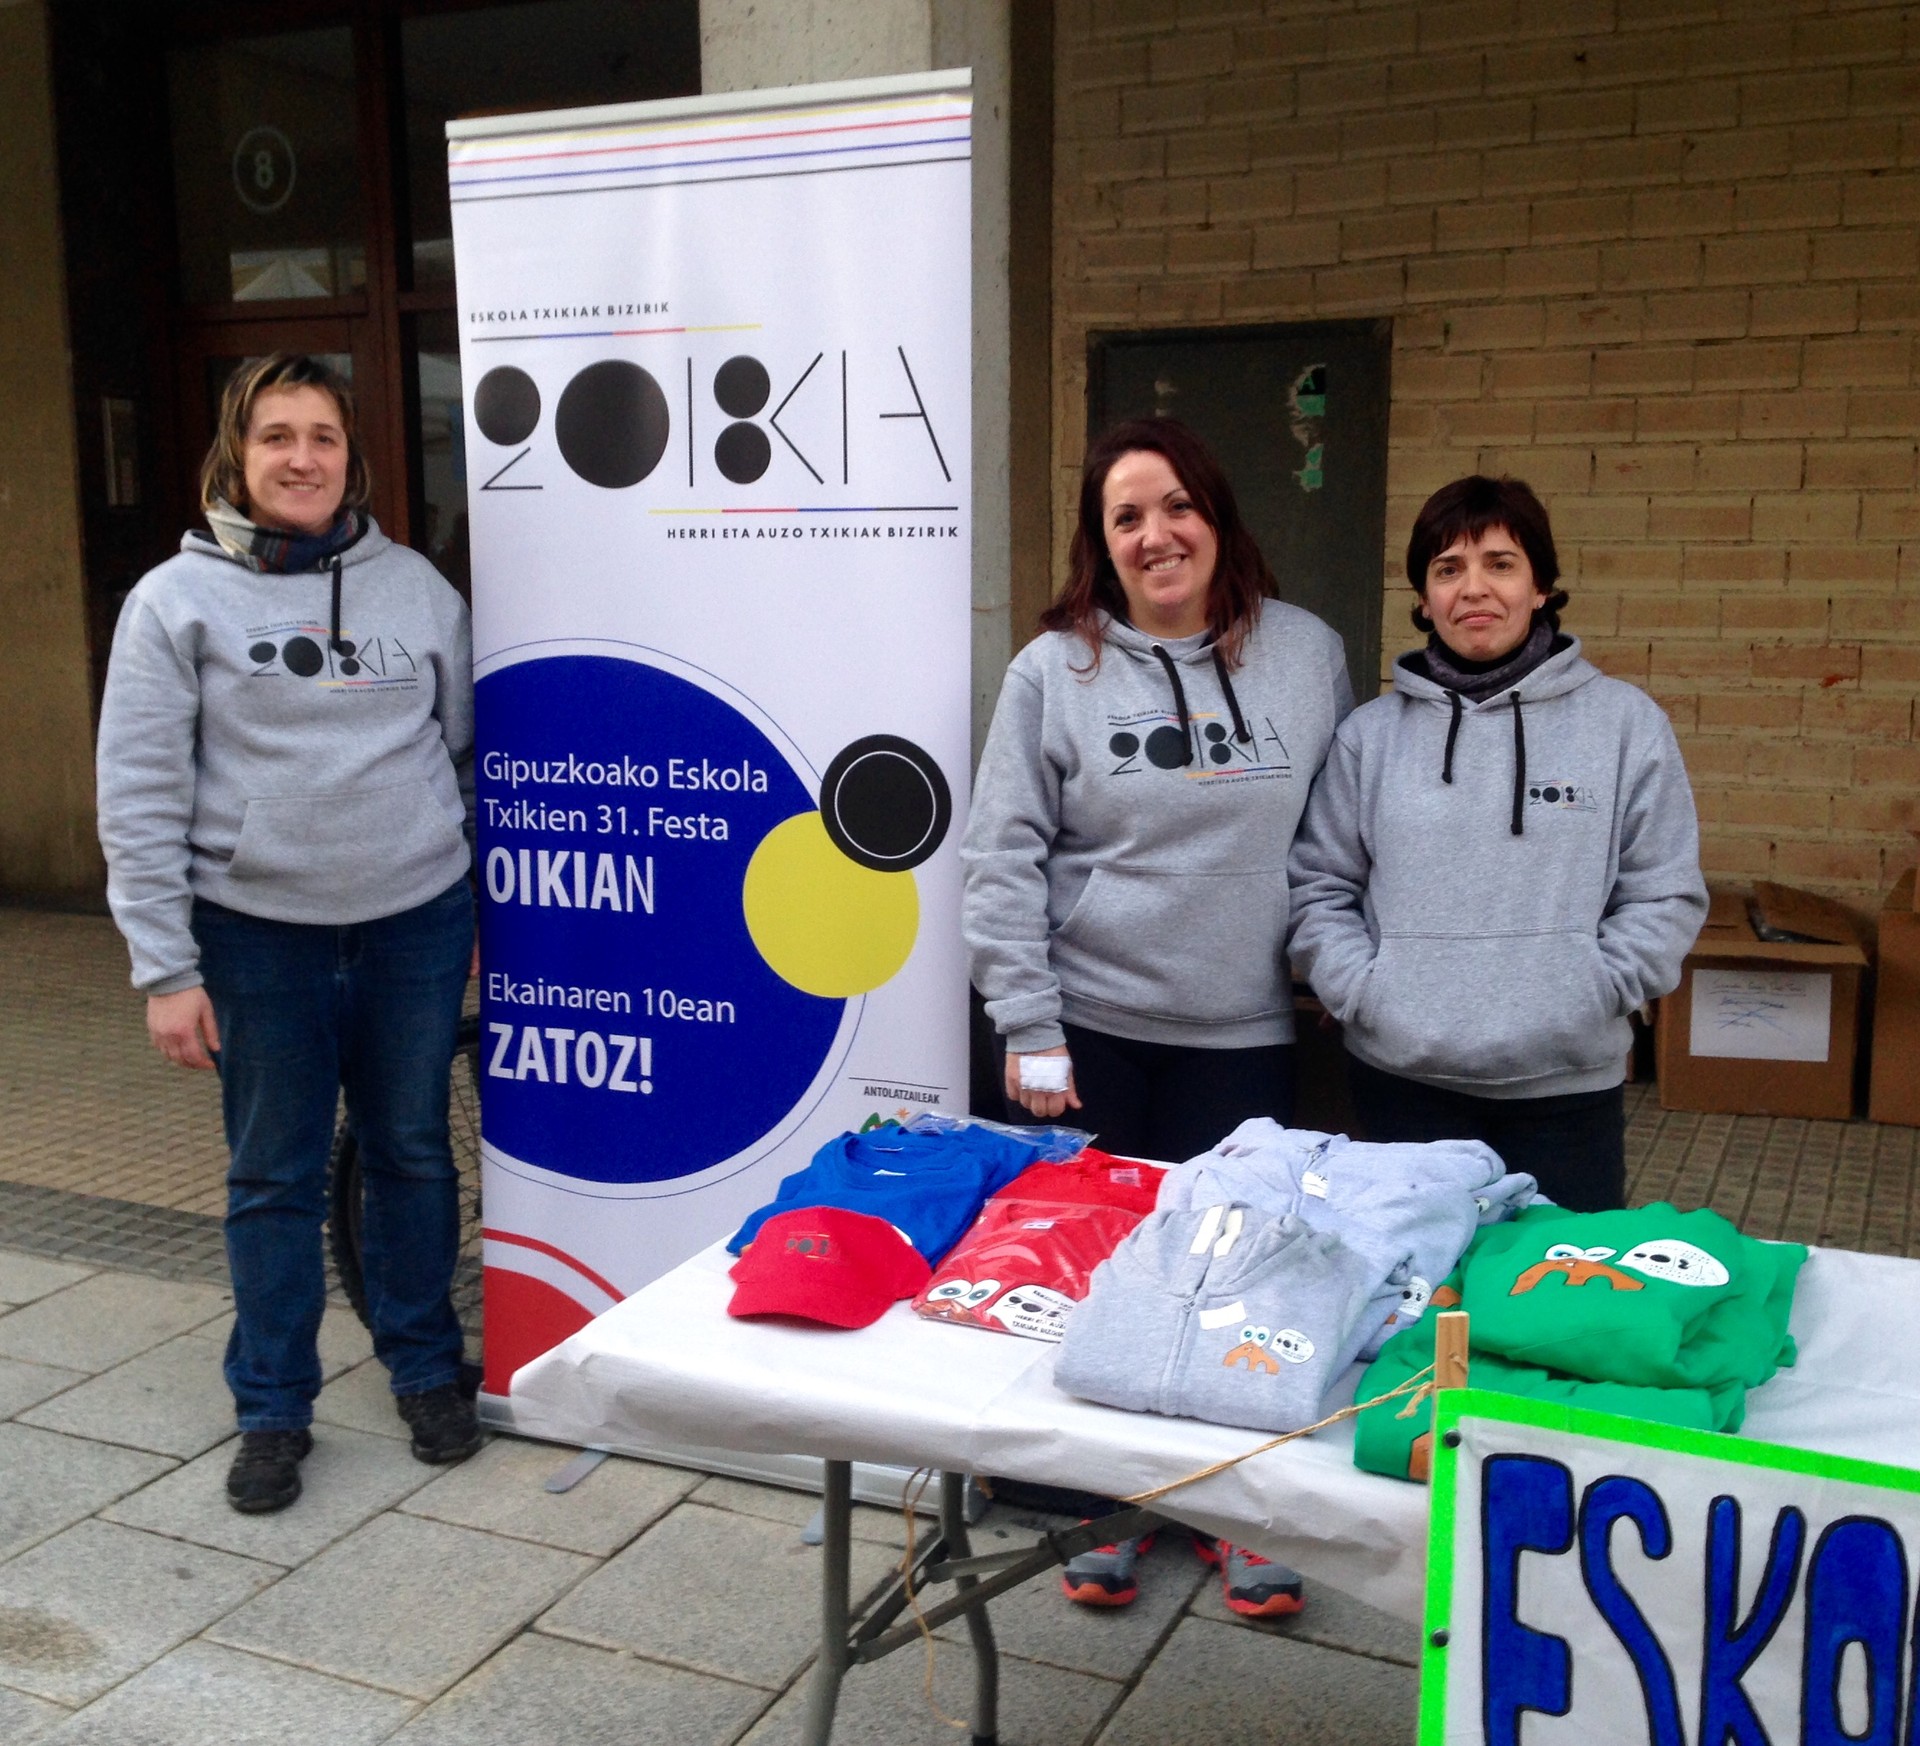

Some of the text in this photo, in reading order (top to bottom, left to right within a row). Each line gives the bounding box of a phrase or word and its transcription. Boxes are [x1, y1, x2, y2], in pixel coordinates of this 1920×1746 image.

[253, 150, 275, 190] 8
[470, 301, 670, 323] ESKOLA TXIKIAK BIZIRIK
[667, 526, 959, 540] HERRI ETA AUZO TXIKIAK BIZIRIK
[483, 751, 769, 793] Gipuzkoako Eskola
[484, 798, 730, 841] Txikien 31. Festa
[485, 846, 655, 915] OIKIAN
[488, 973, 736, 1024] Ekainaren 10ean
[487, 1022, 655, 1095] ZATOZ!
[863, 1085, 941, 1104] ANTOLATZAILEAK
[1481, 1452, 1920, 1746] ESKO
